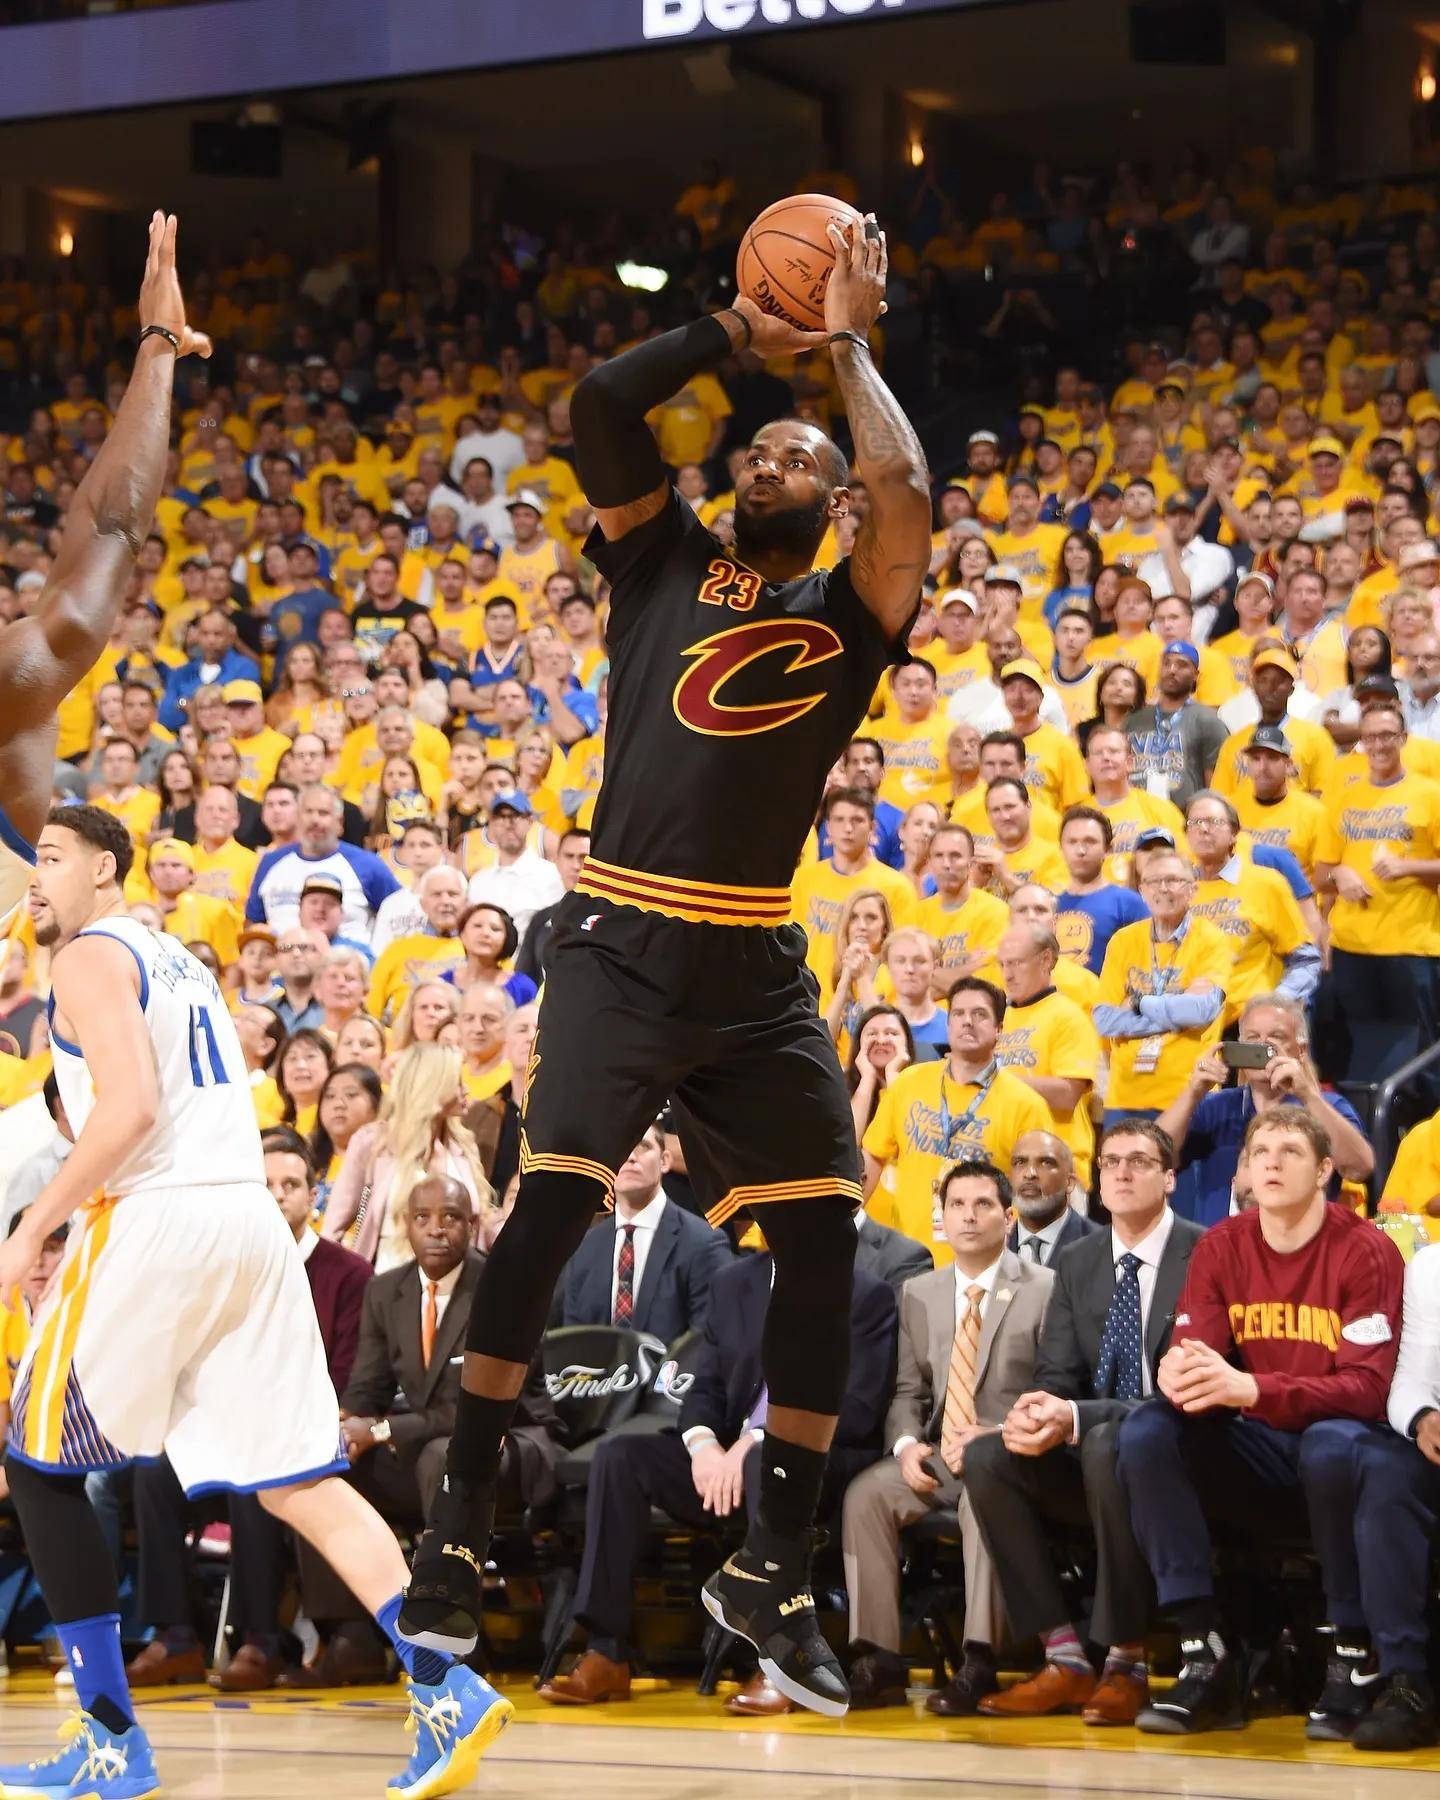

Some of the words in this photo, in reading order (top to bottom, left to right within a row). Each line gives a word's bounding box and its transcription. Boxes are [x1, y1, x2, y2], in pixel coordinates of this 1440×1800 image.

[698, 559, 761, 612] 23
[672, 618, 845, 737] C
[189, 1003, 232, 1088] 11
